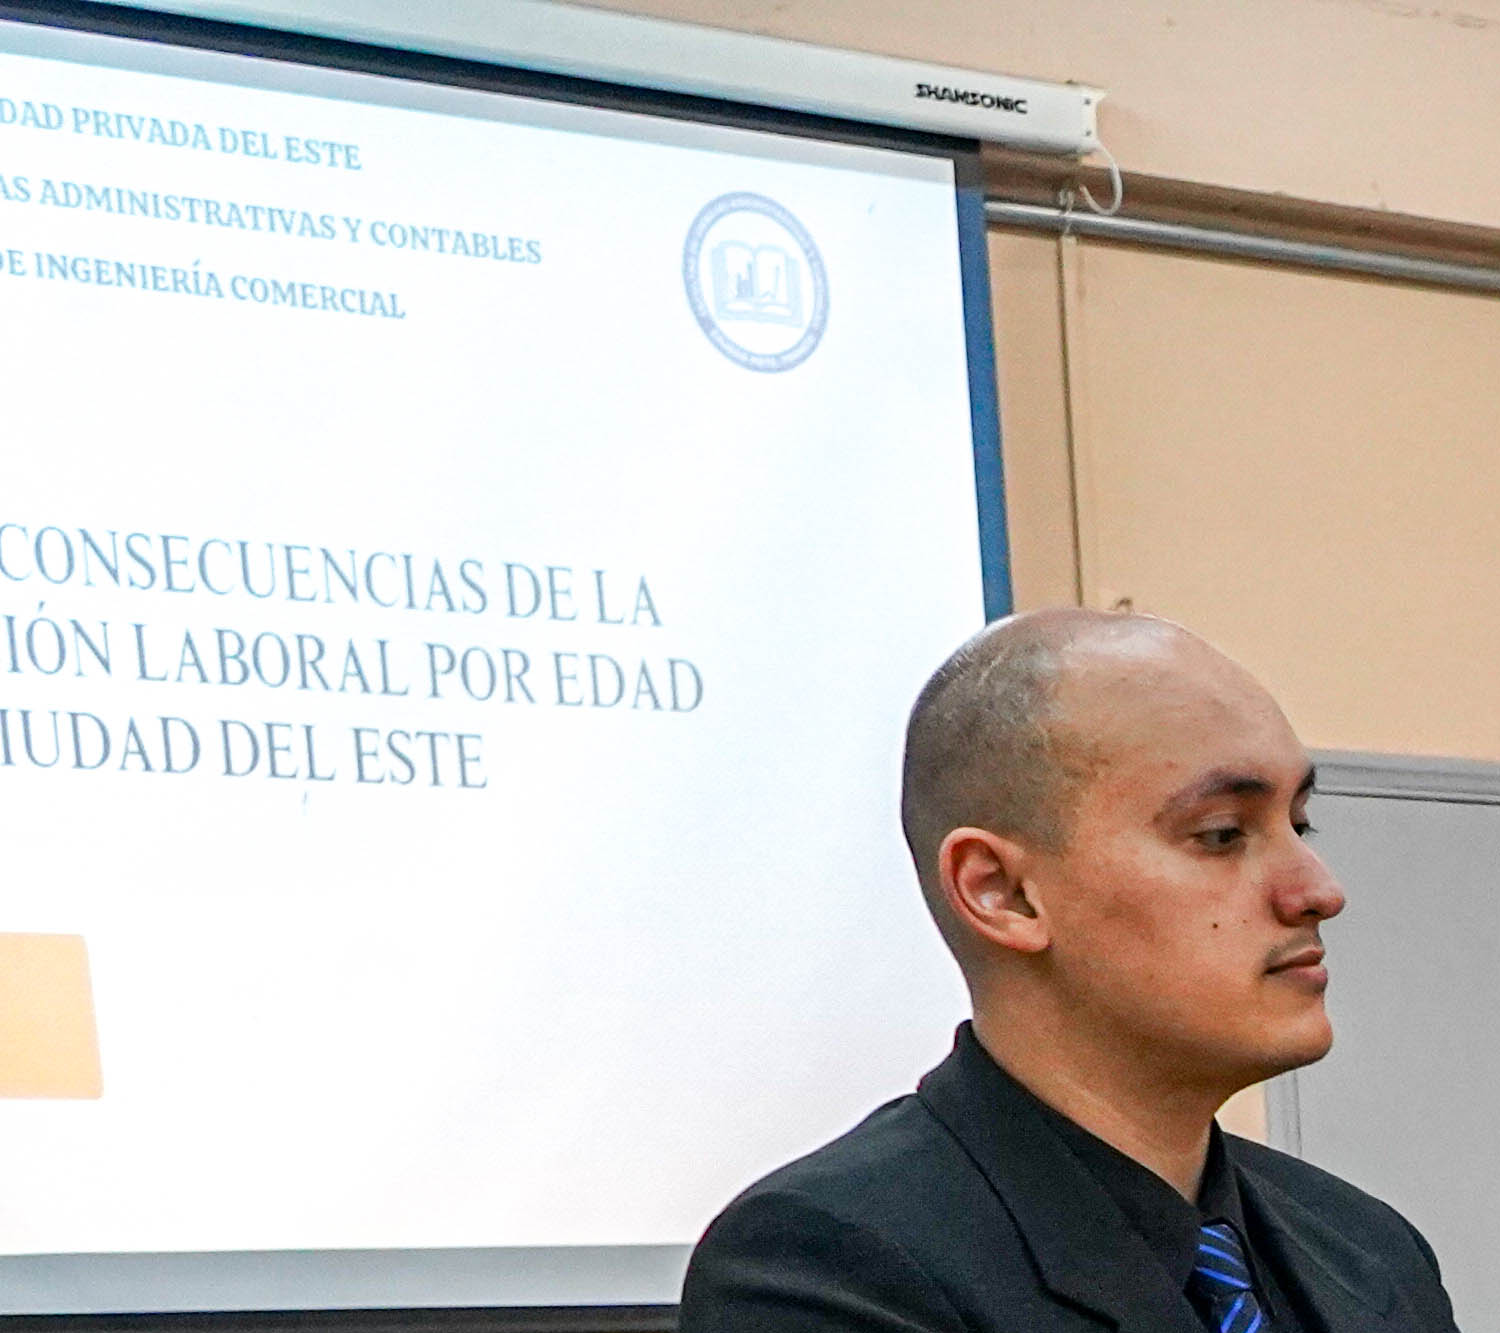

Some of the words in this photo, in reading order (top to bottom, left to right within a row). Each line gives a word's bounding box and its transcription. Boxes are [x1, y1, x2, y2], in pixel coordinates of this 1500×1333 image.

[72, 107, 213, 151] PRIVADA
[219, 127, 278, 159] DEL
[284, 136, 362, 170] ESTE
[40, 178, 336, 240] ADMINISTRATIVAS
[343, 217, 362, 243] Y
[370, 221, 542, 264] CONTABLES
[0, 249, 26, 276] E
[34, 252, 224, 299] INGENIERÍA
[231, 275, 406, 319] COMERCIAL
[0, 523, 487, 614] CONSECUENCIAS
[503, 562, 577, 621] DE
[592, 569, 663, 627] LA
[2, 600, 111, 677] IÓN
[133, 623, 408, 696] LABORAL
[425, 642, 536, 704] POR
[552, 652, 703, 712] EDAD
[0, 709, 200, 774] IUDAD
[218, 719, 336, 781] DEL
[351, 727, 487, 789] ESTE
